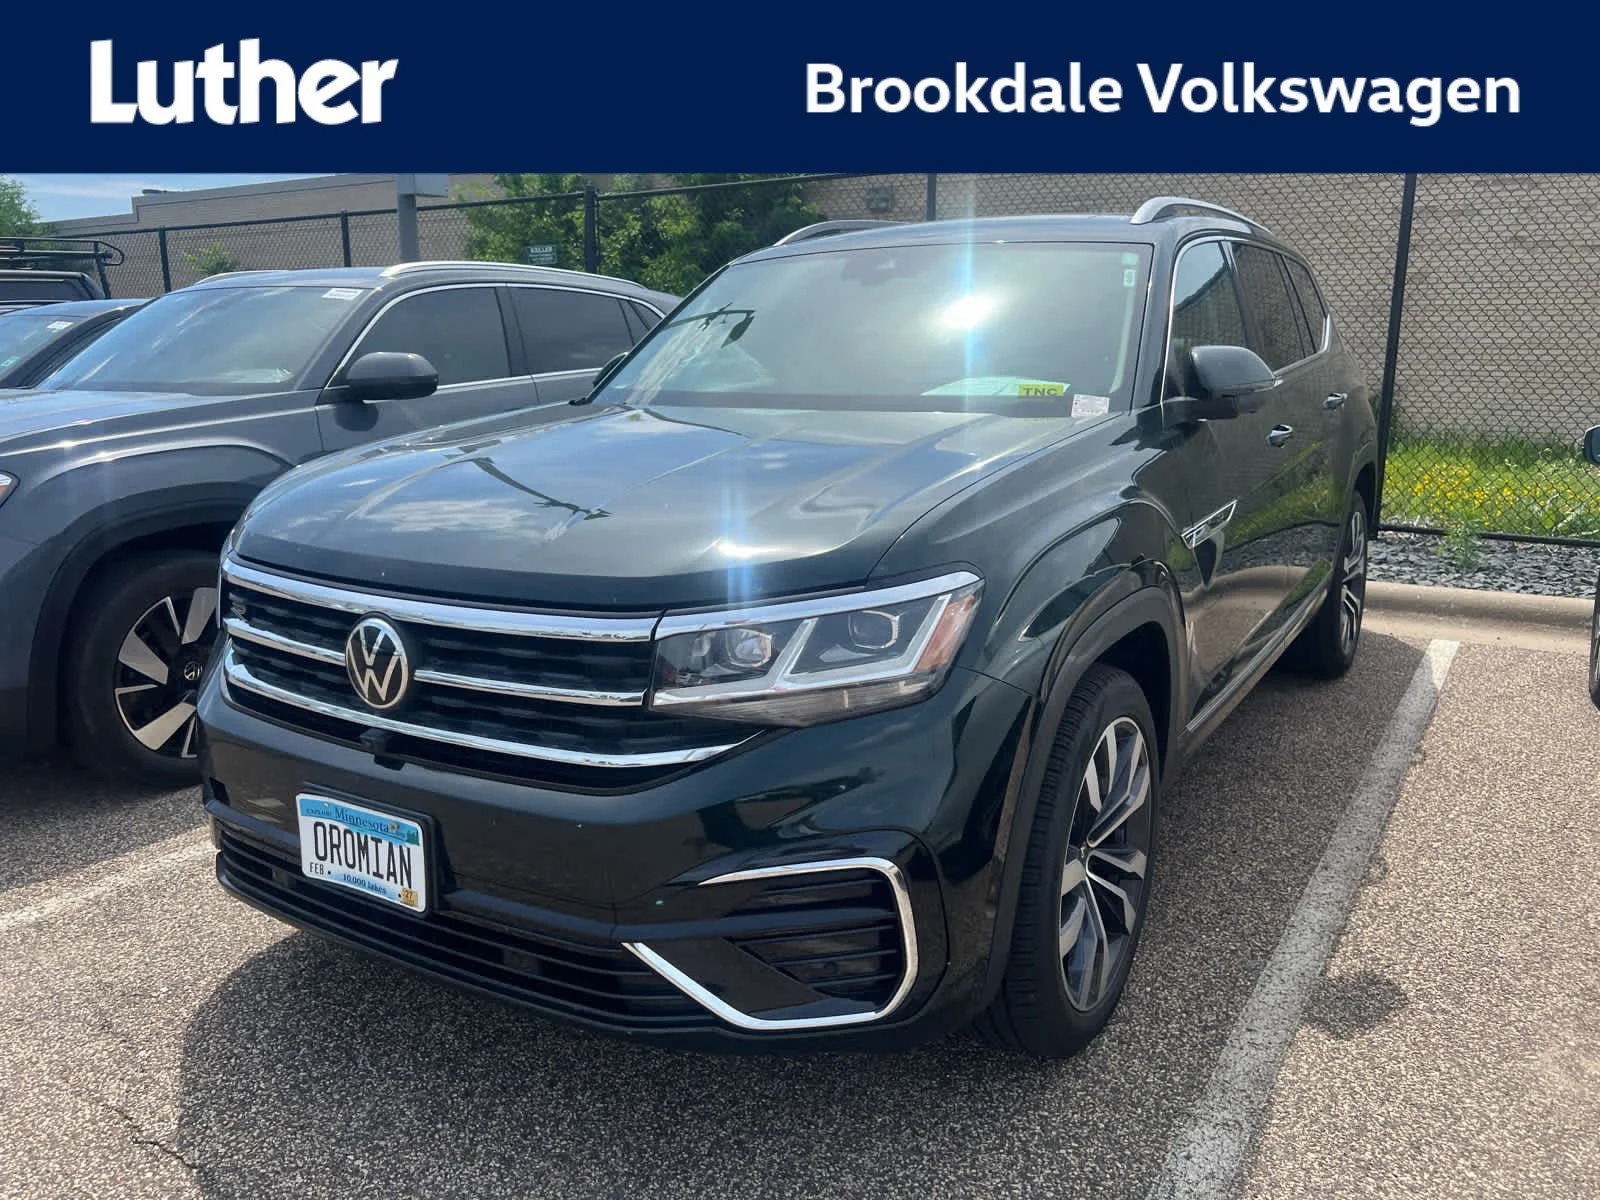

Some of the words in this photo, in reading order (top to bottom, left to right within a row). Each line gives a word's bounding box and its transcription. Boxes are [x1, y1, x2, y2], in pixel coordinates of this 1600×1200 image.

[1023, 387, 1057, 398] TNC
[334, 806, 390, 833] Minnesota
[313, 821, 412, 889] OROMIAN
[309, 862, 325, 876] FEB
